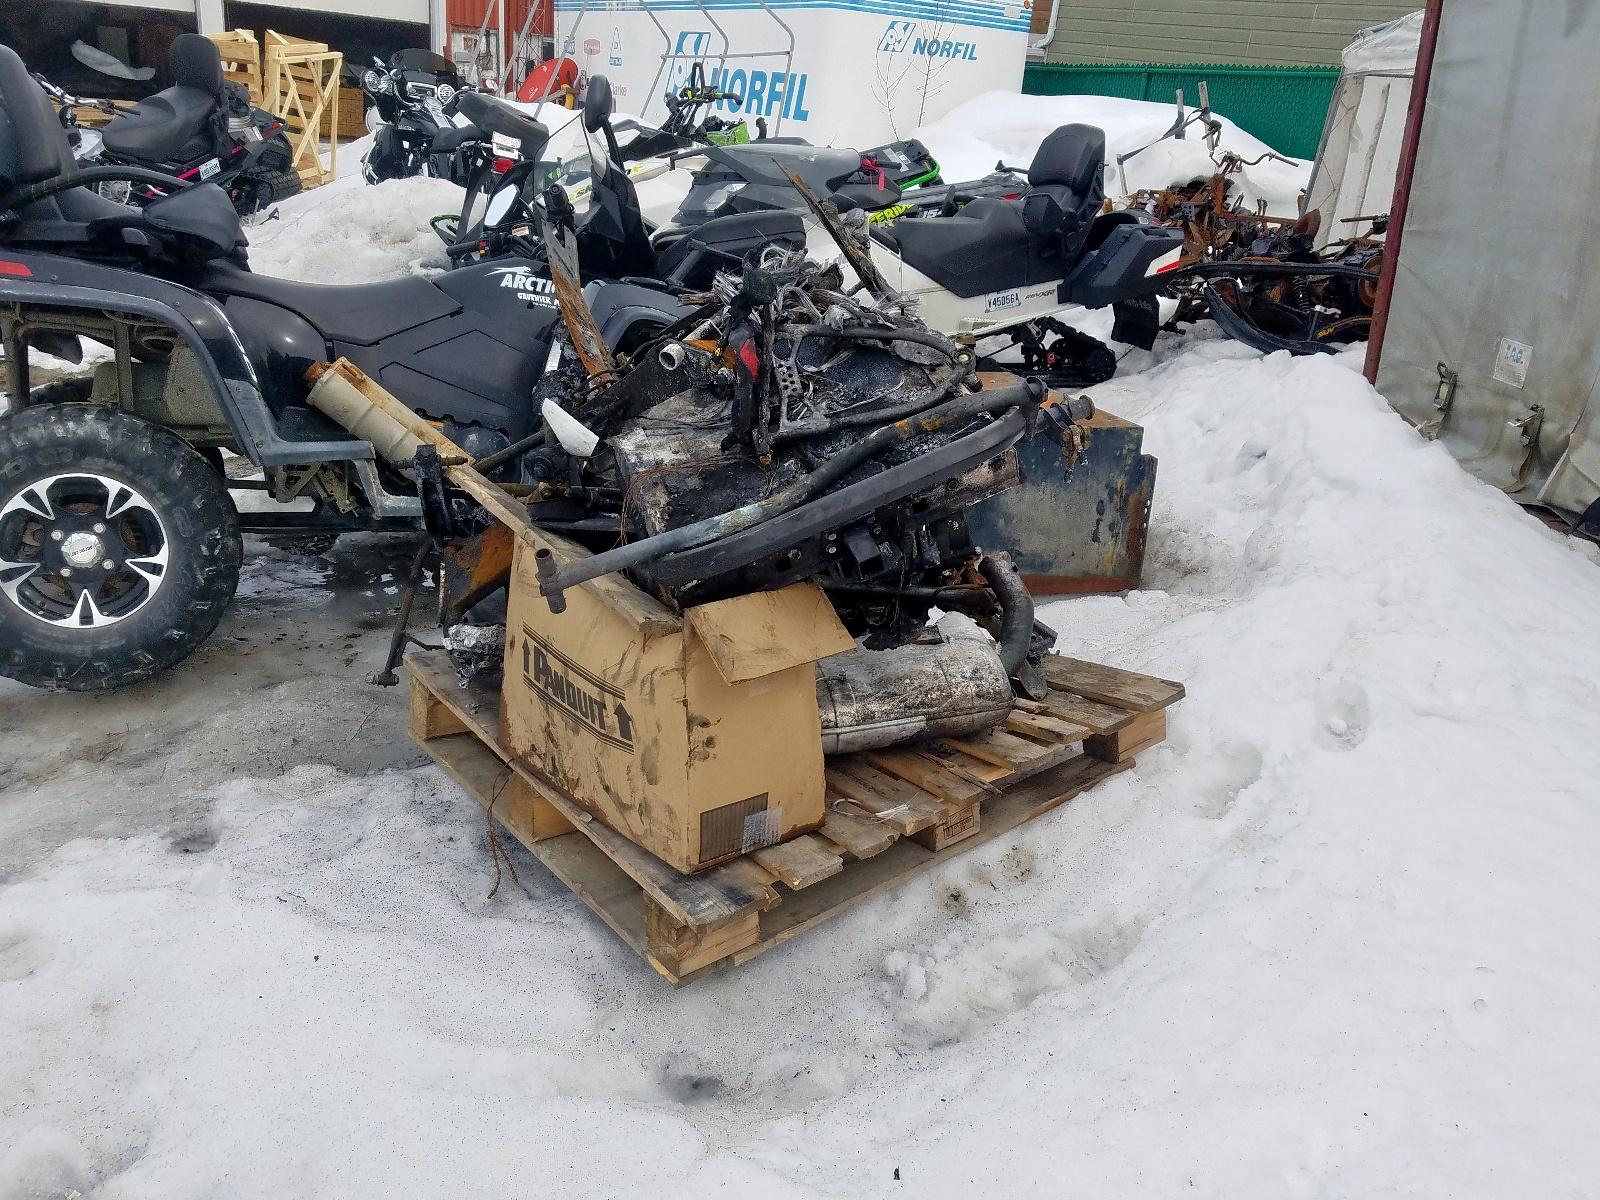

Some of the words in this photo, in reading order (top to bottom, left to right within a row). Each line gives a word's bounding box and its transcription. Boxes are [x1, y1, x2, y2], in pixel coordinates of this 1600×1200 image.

[912, 37, 979, 61] NORFIL
[710, 66, 809, 122] NORFIL
[533, 644, 607, 731] PANDUIT
